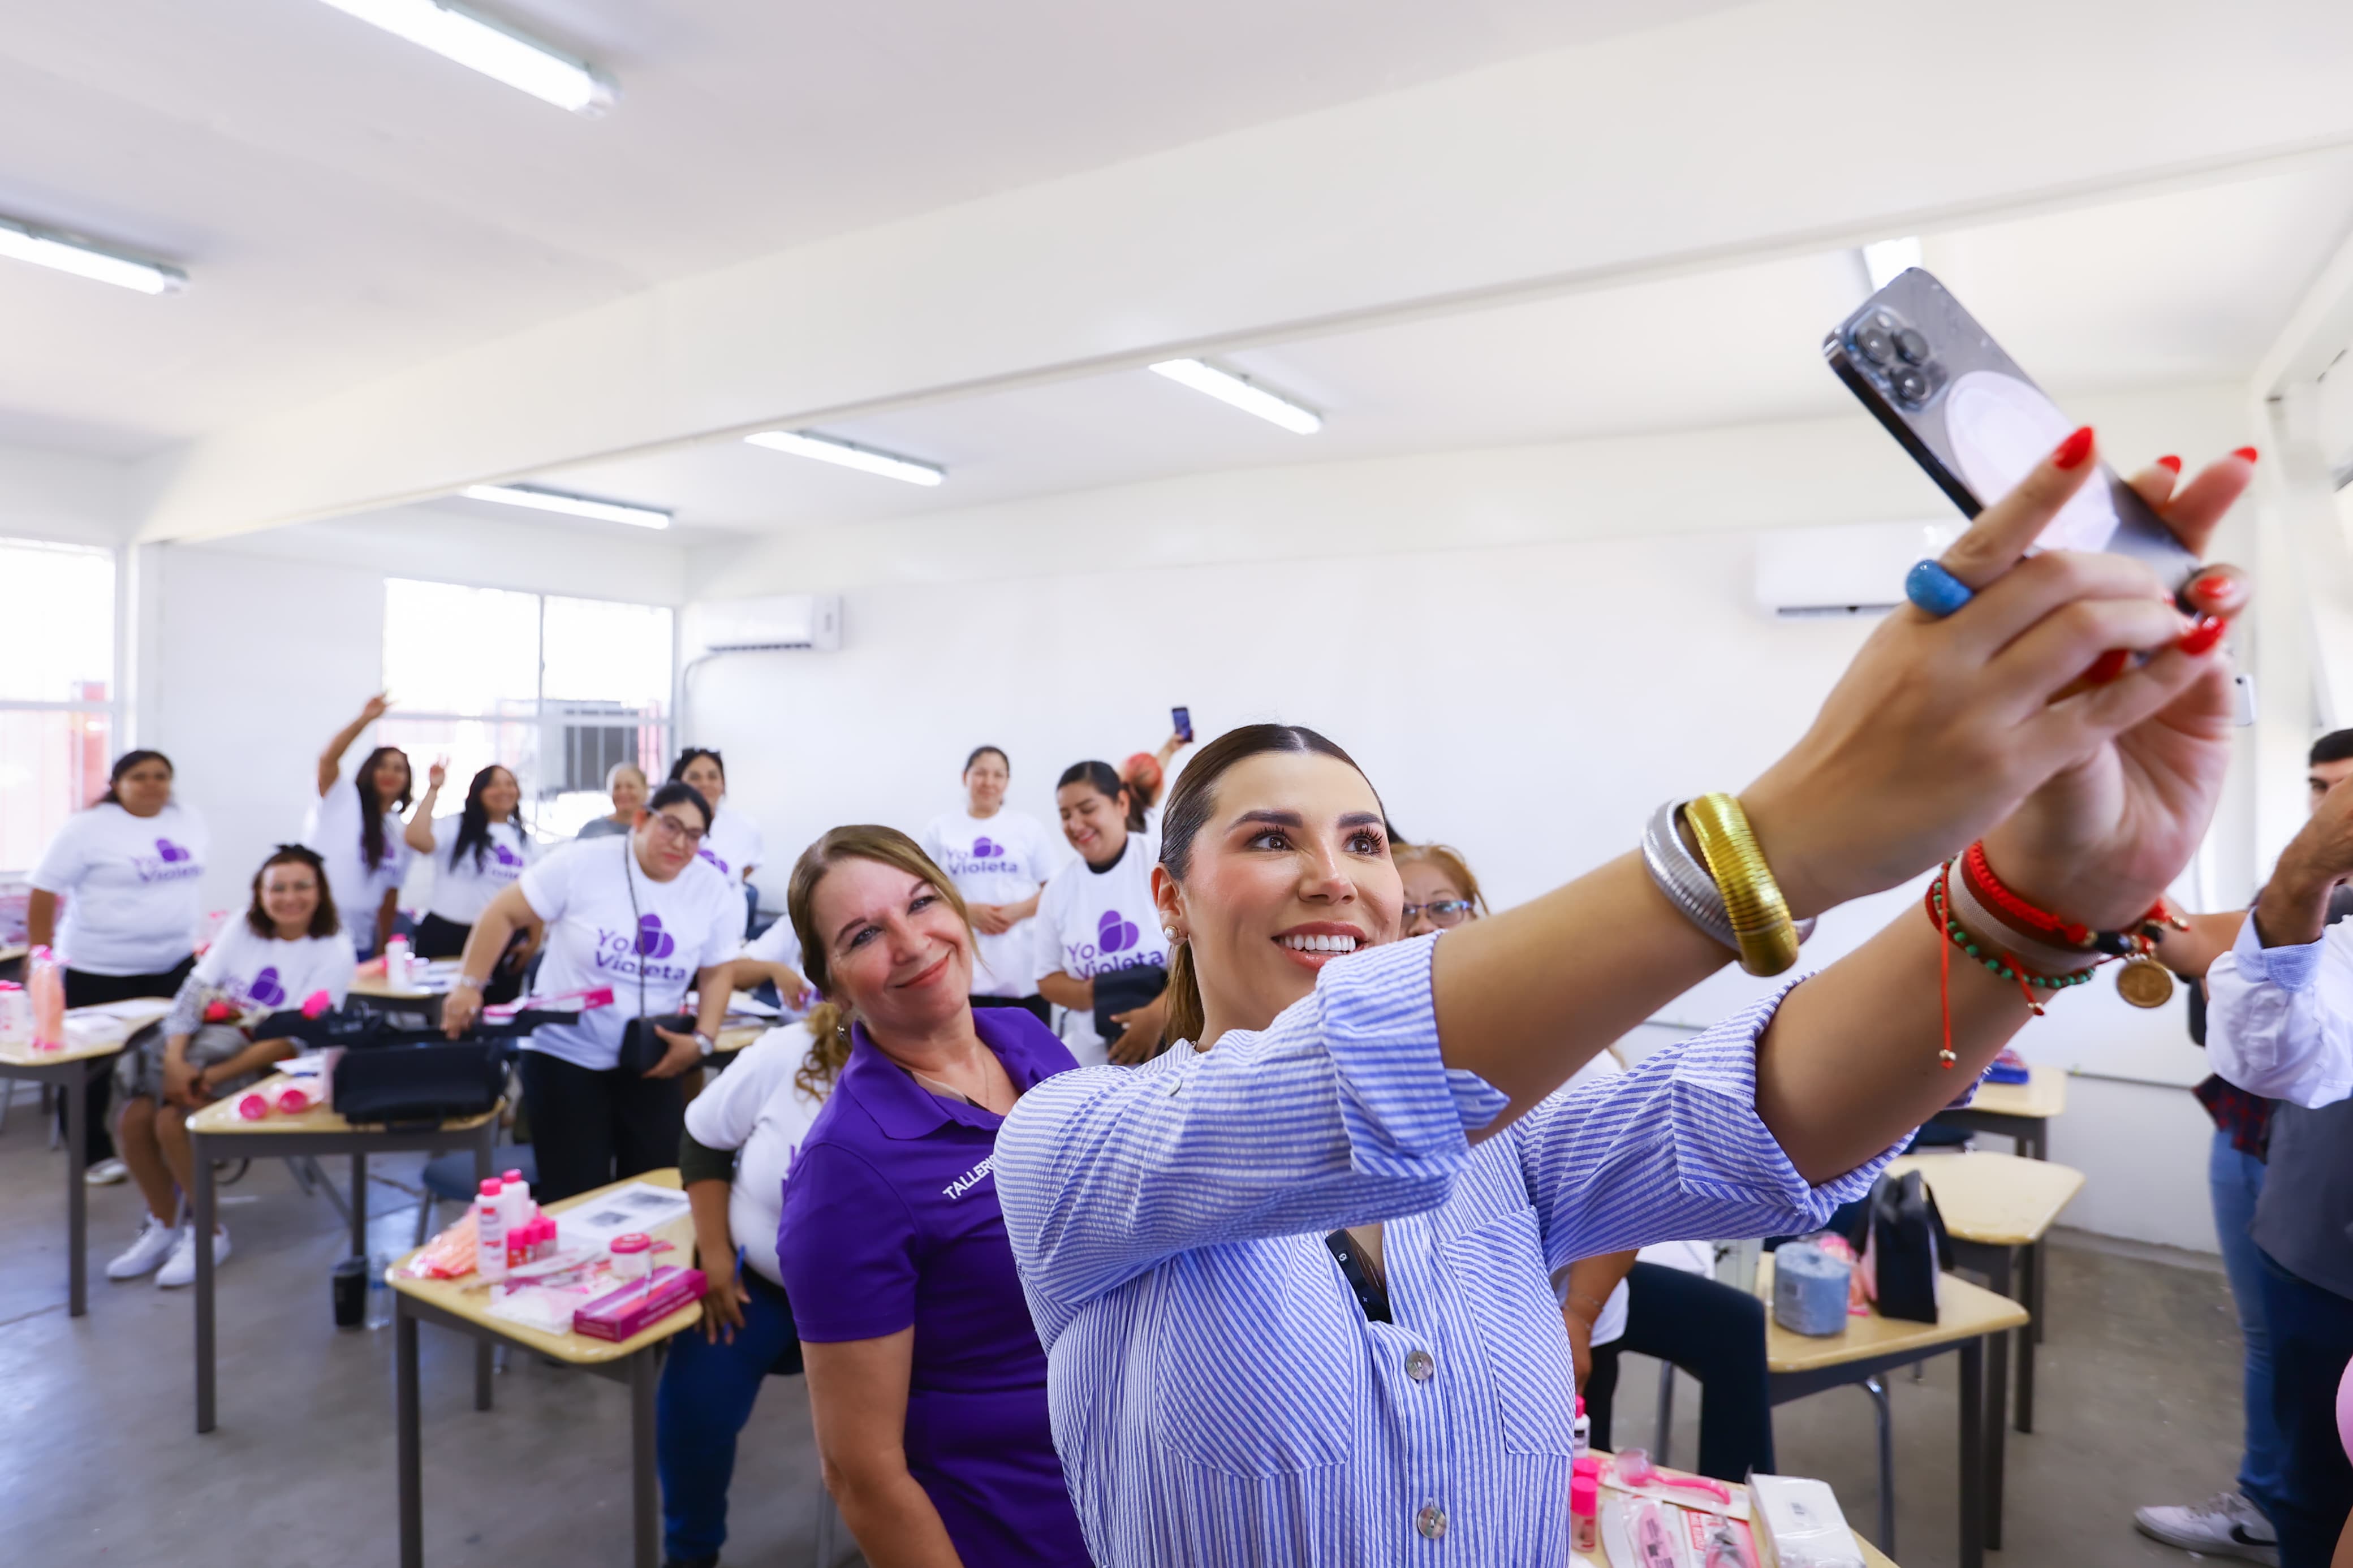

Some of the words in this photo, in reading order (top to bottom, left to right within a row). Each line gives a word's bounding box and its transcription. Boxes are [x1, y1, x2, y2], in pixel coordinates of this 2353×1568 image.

[948, 861, 1018, 875] Violeta
[598, 927, 629, 951] Yo
[1067, 942, 1095, 963] Yo
